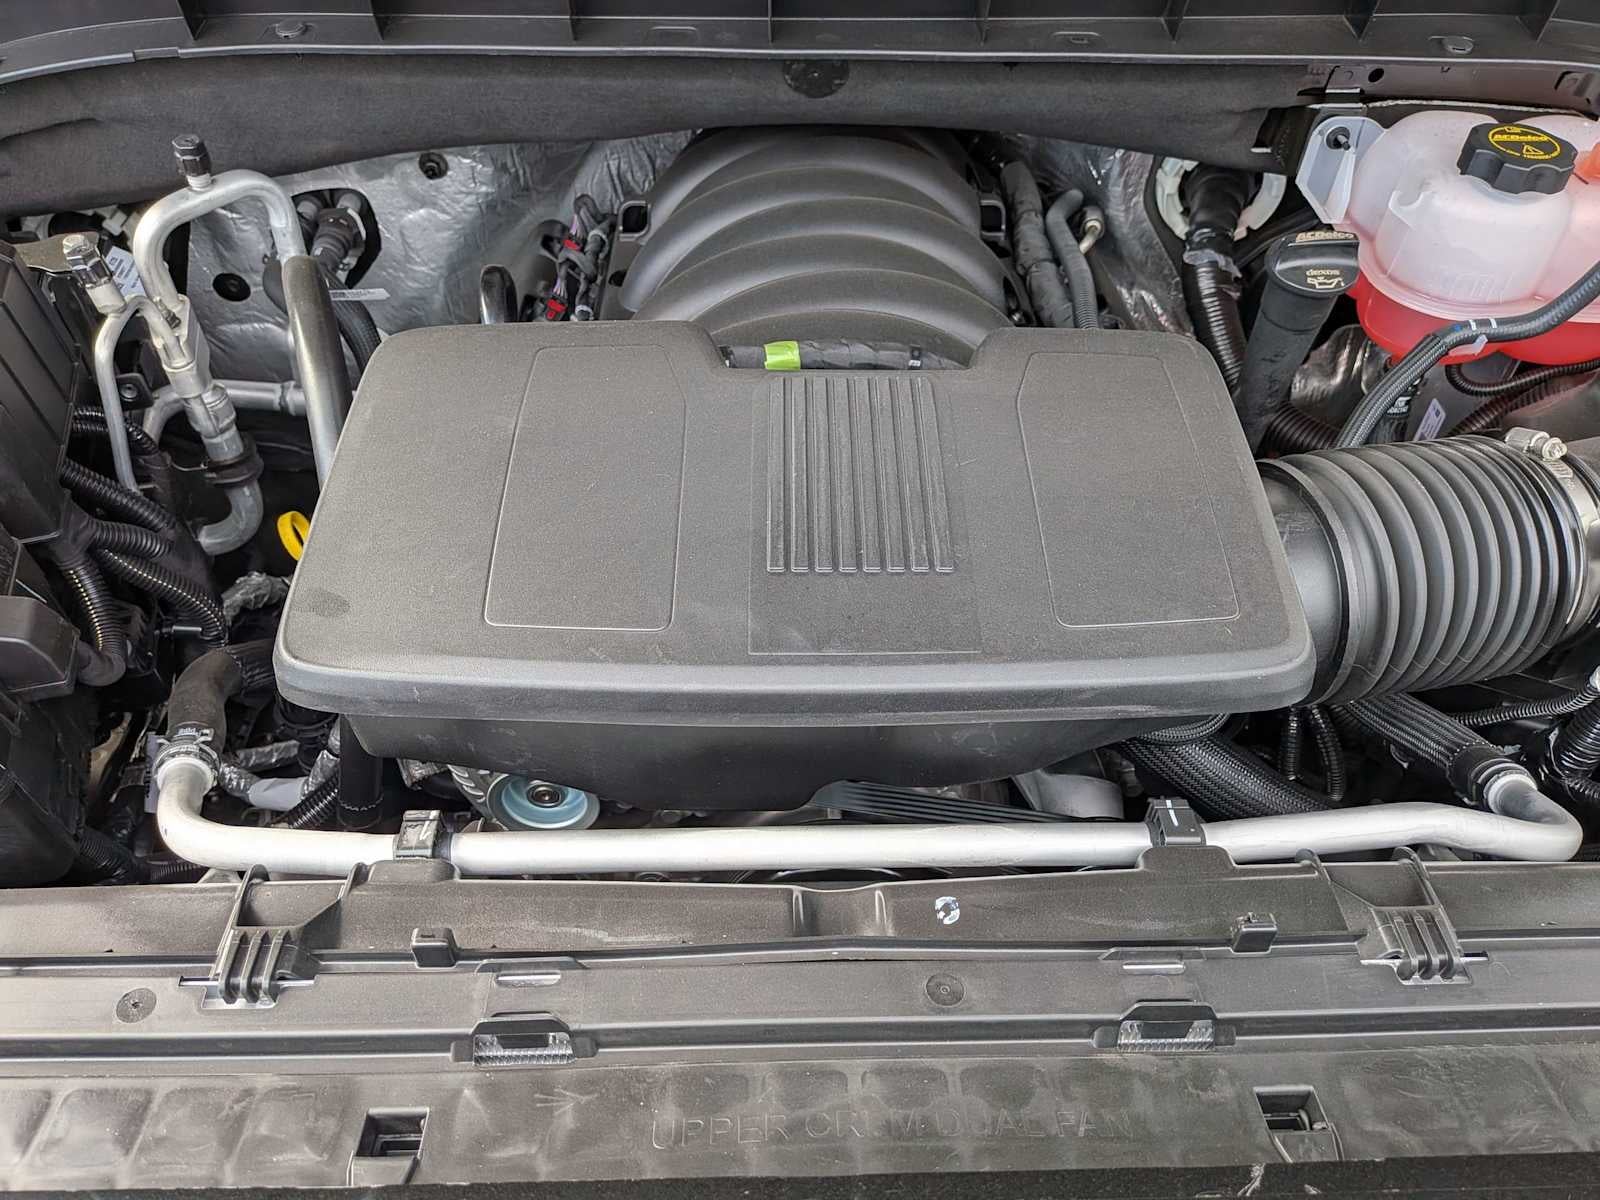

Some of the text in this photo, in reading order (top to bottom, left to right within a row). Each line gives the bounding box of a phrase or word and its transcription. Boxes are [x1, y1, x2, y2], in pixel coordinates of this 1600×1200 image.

[1493, 133, 1549, 142] ACDelco
[1296, 231, 1356, 242] ACDelco
[652, 1110, 790, 1150] UPPER
[935, 1106, 1046, 1138] DUAL
[1056, 1105, 1134, 1138] FAN
